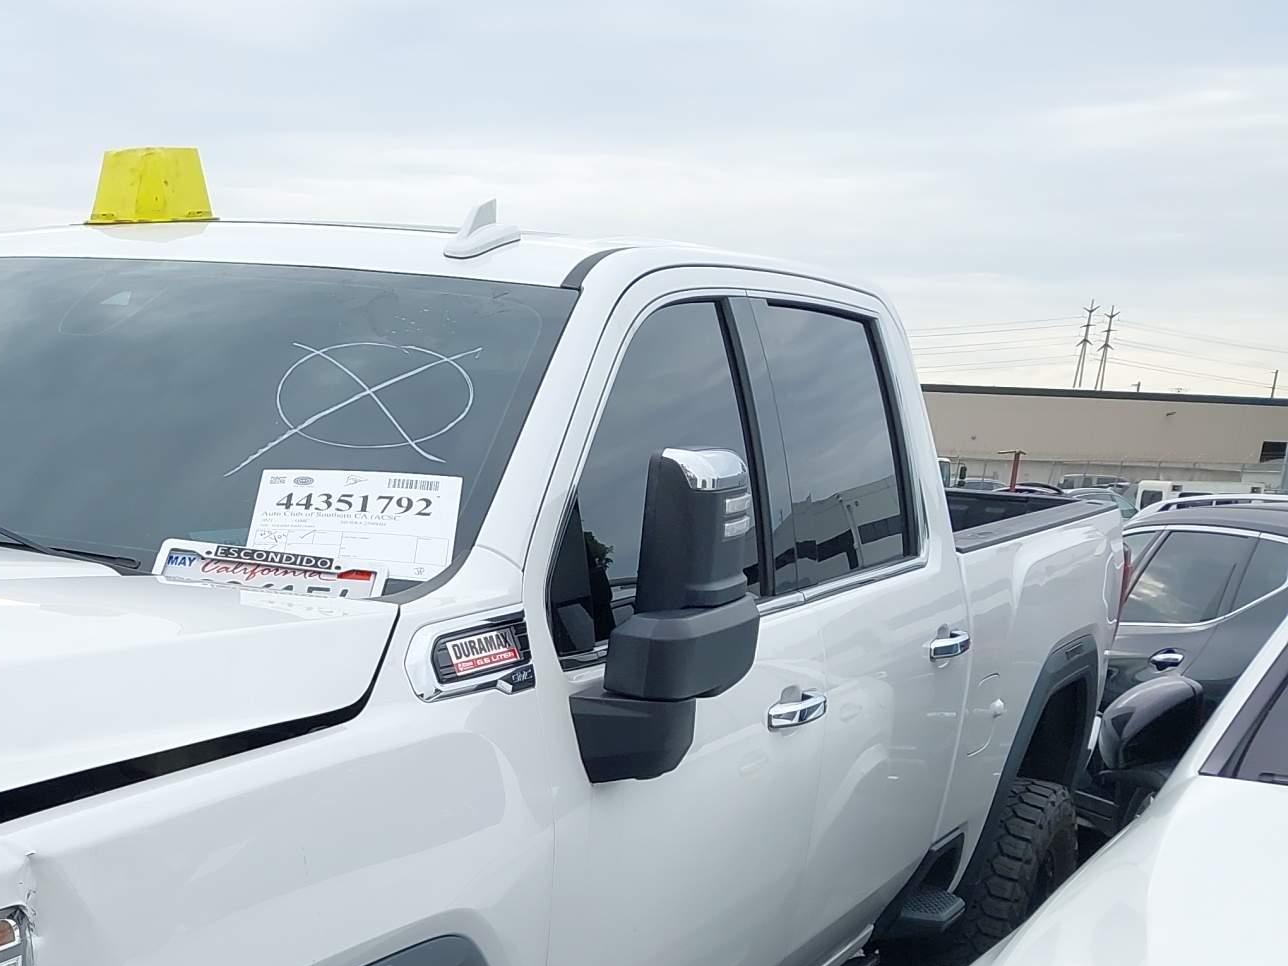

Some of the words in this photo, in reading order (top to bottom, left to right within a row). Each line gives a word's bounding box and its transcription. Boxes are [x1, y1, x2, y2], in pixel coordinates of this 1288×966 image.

[276, 492, 433, 517] 44351792
[167, 555, 196, 567] MAY
[216, 546, 332, 569] ESCONDIDO
[200, 559, 337, 581] California
[452, 631, 512, 660] DURAMAX
[491, 651, 515, 662] LITER
